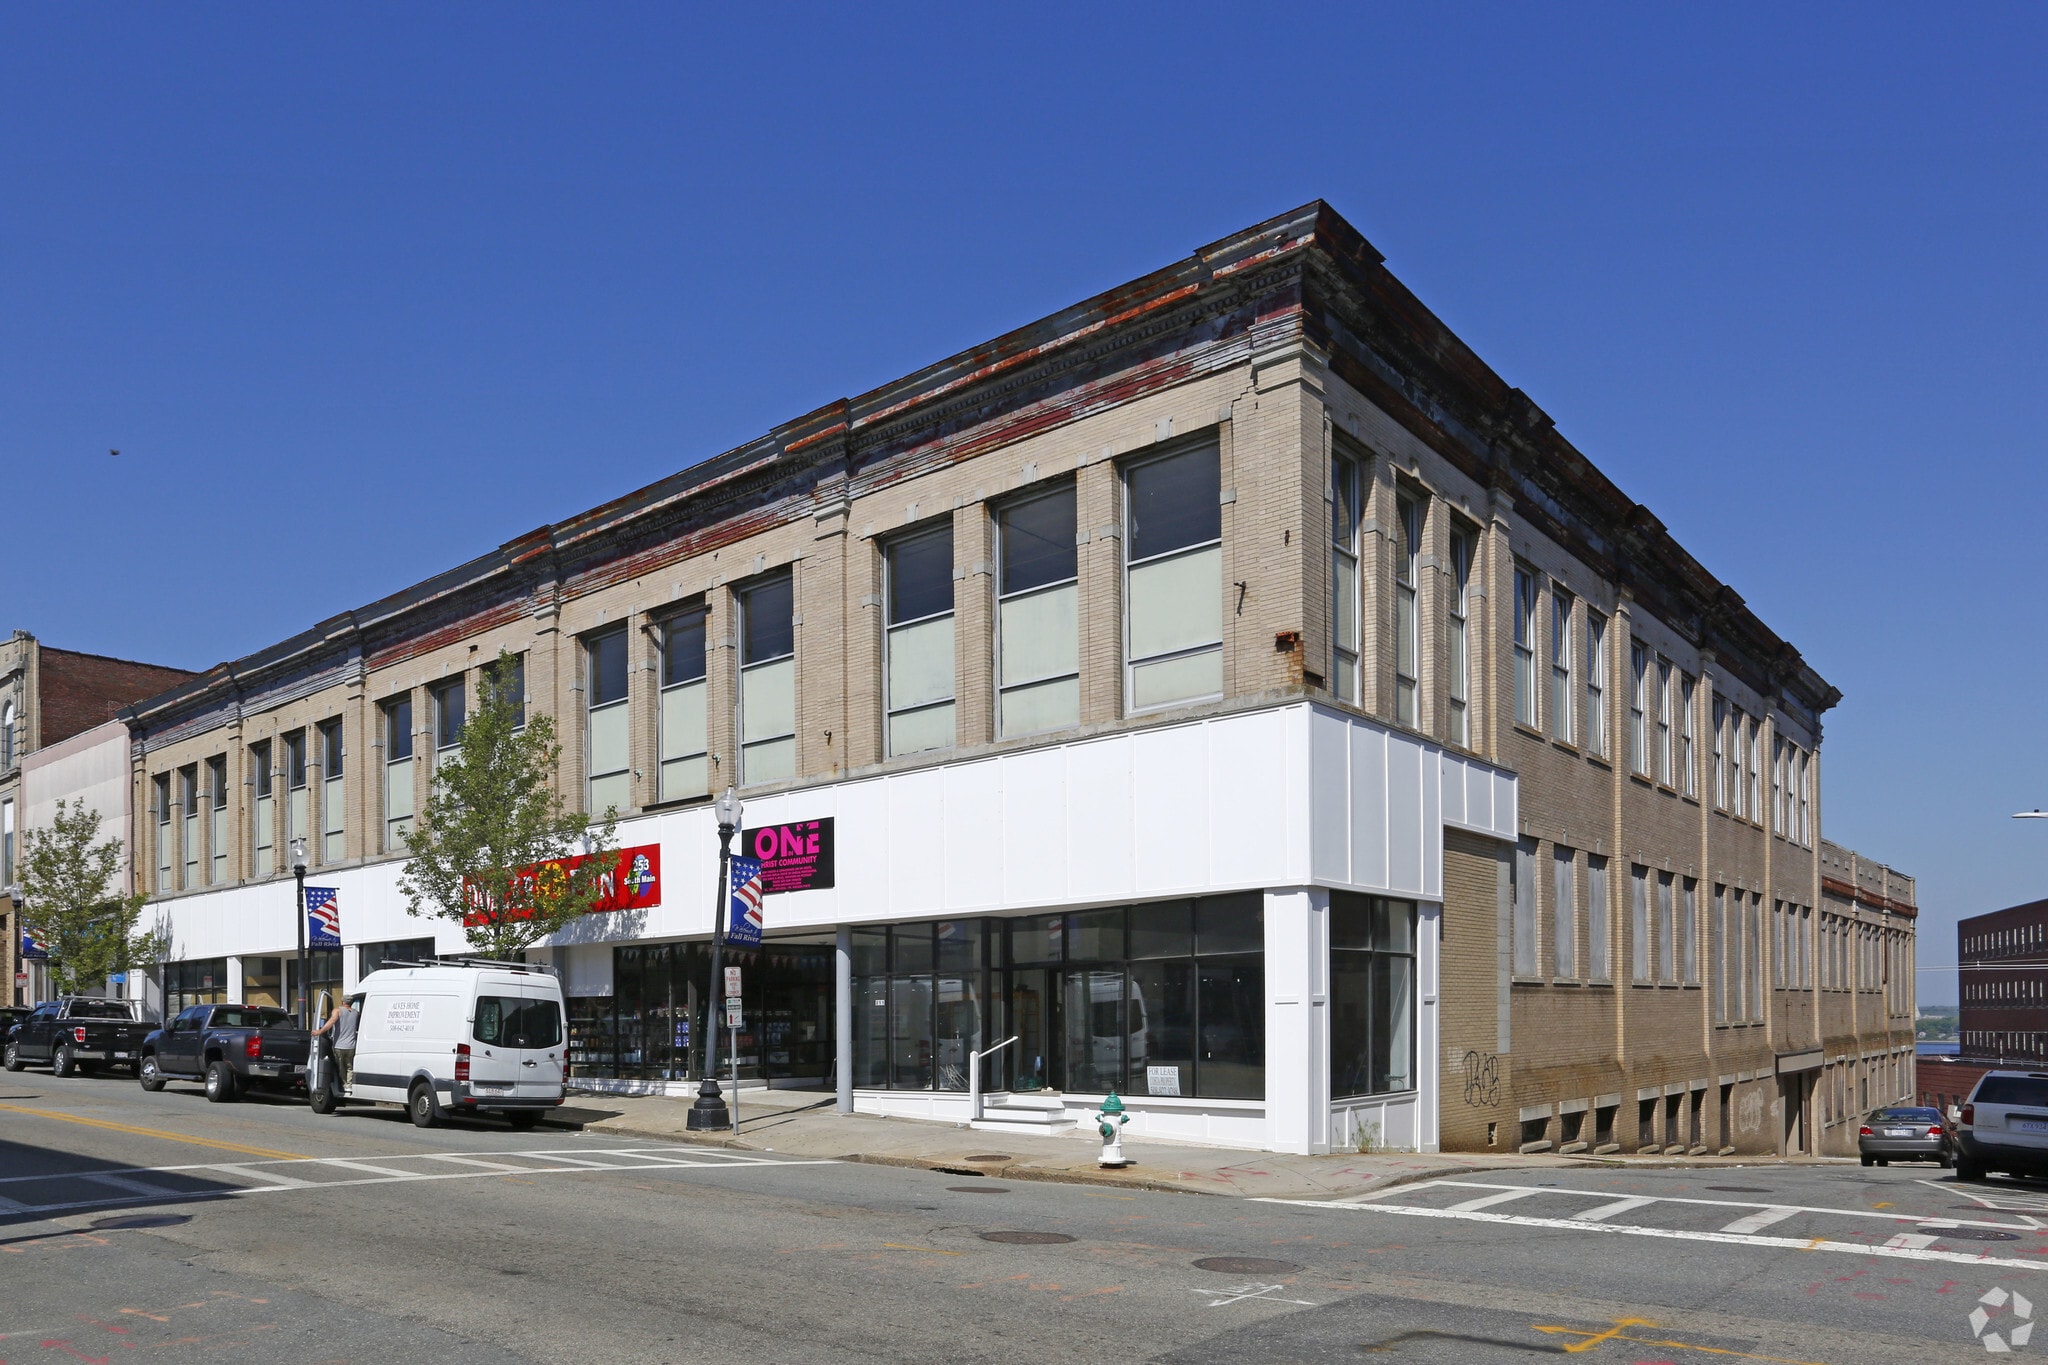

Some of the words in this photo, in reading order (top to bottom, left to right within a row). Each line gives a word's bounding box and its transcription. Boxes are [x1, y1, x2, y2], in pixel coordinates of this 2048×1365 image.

[754, 821, 819, 860] ONE
[633, 858, 650, 872] 253
[761, 860, 777, 868] HRIST
[779, 856, 817, 866] COMMUNITY
[641, 873, 656, 882] Main
[730, 932, 743, 940] Fall
[743, 934, 759, 942] River
[406, 1001, 420, 1010] HOME
[387, 1011, 421, 1019] IMPROVEMENT
[1160, 1068, 1177, 1076] LEASE
